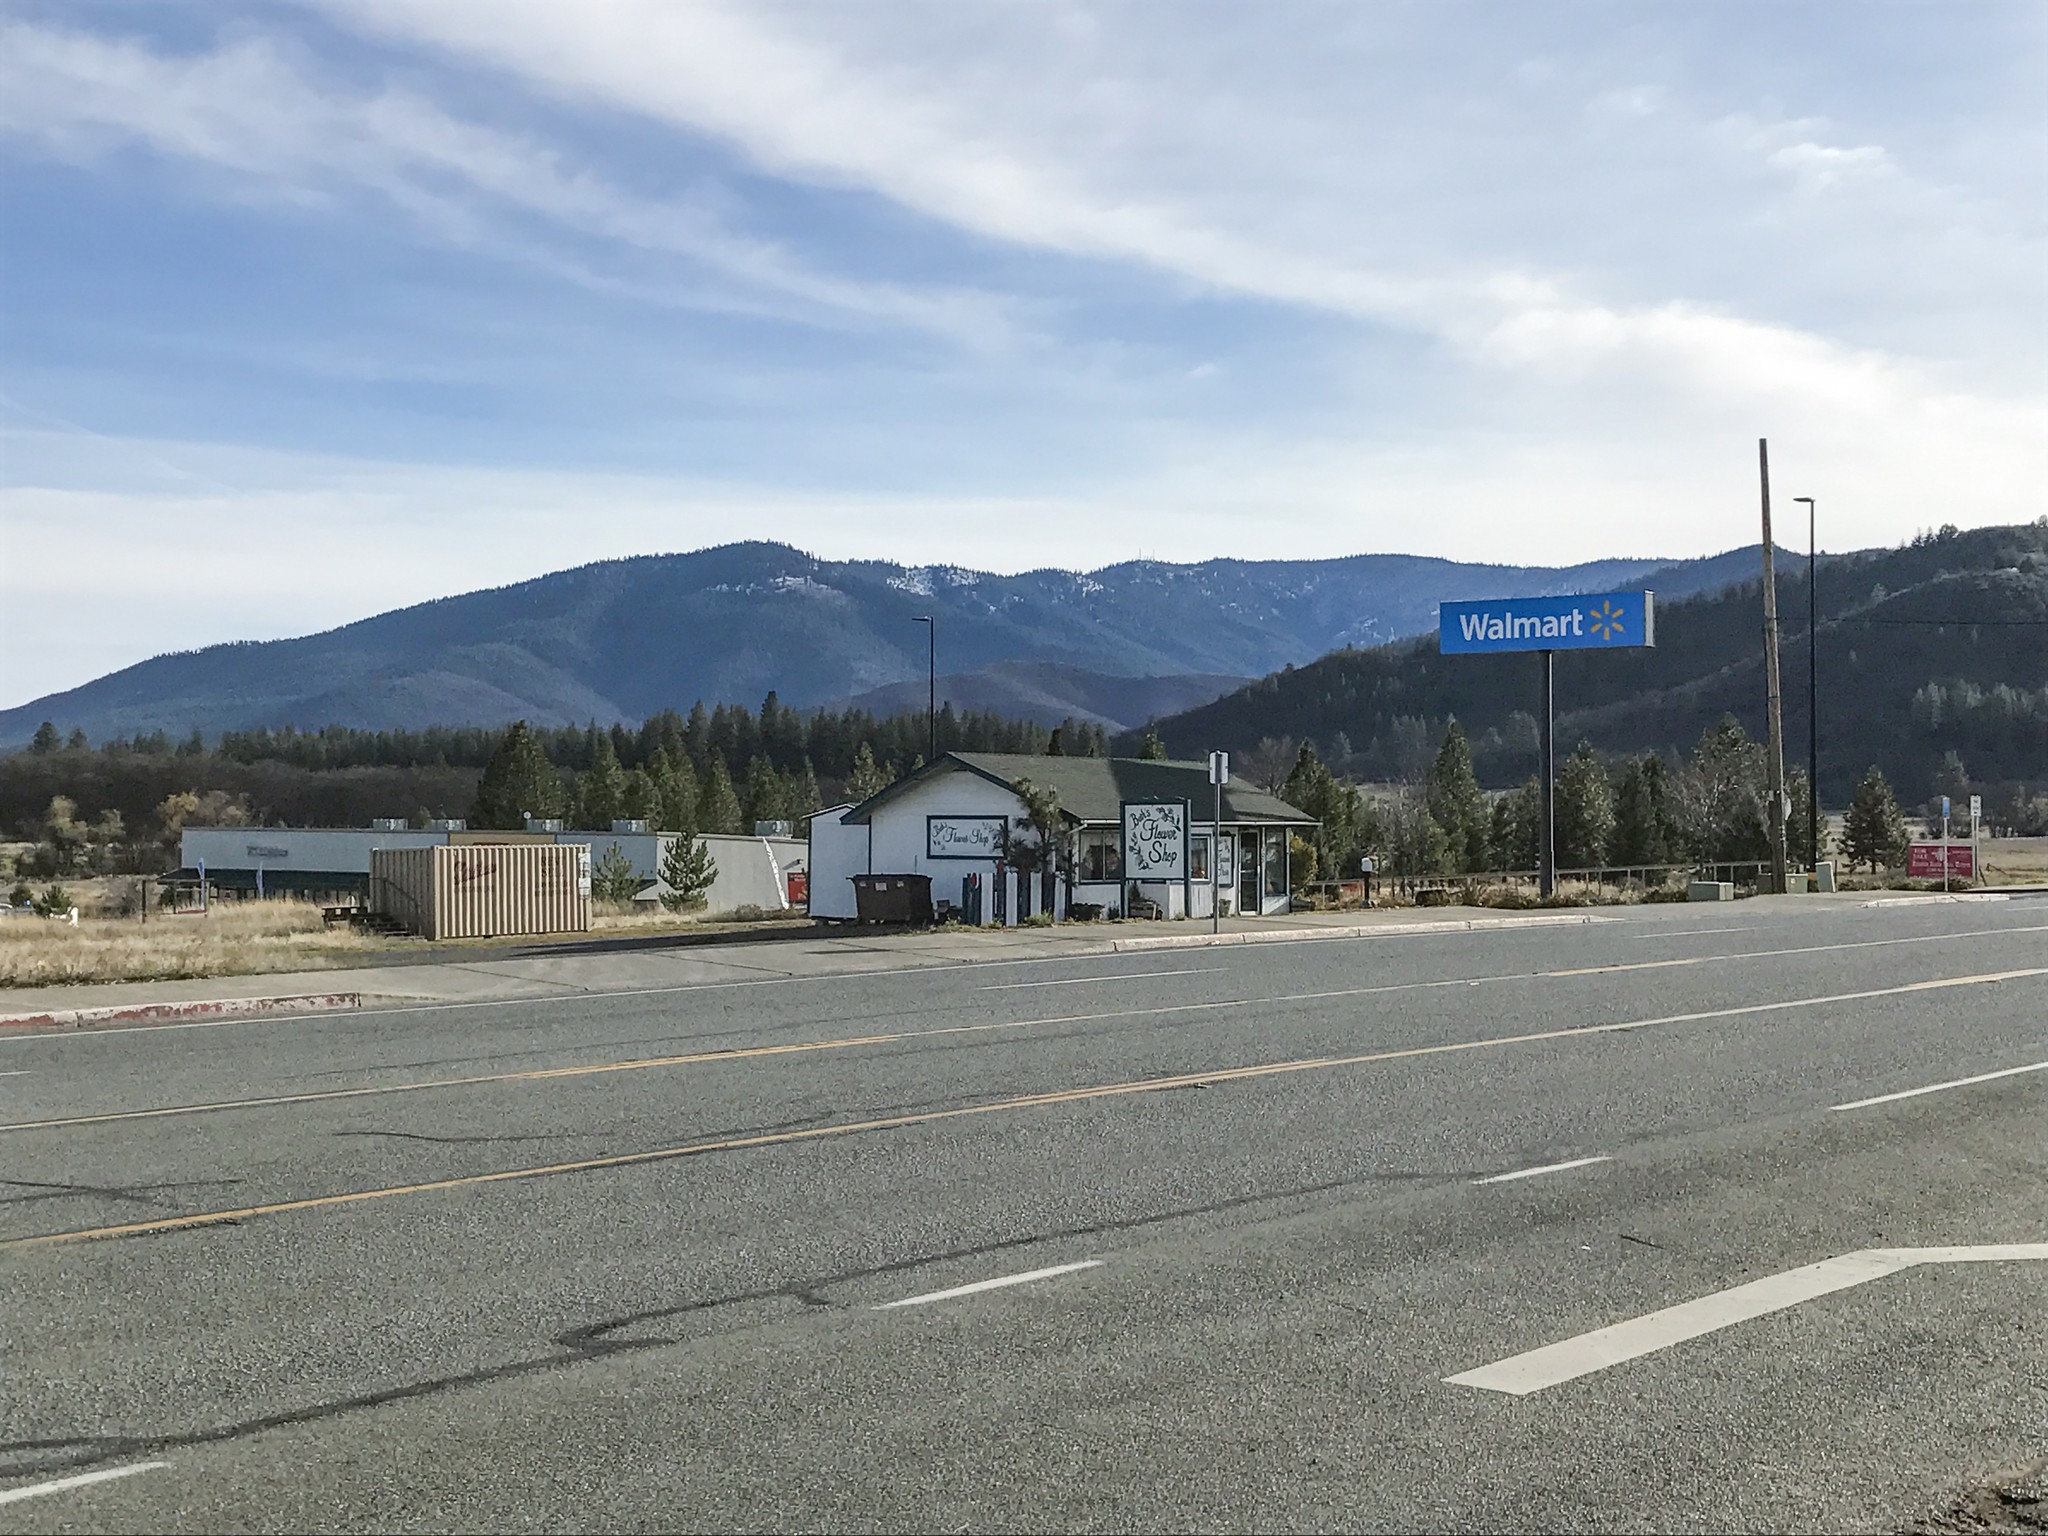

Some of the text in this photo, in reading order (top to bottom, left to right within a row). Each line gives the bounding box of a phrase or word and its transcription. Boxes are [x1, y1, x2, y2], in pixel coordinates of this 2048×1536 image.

[1459, 608, 1584, 642] Walmart
[1139, 818, 1177, 842] Flower
[1148, 840, 1178, 868] Shop
